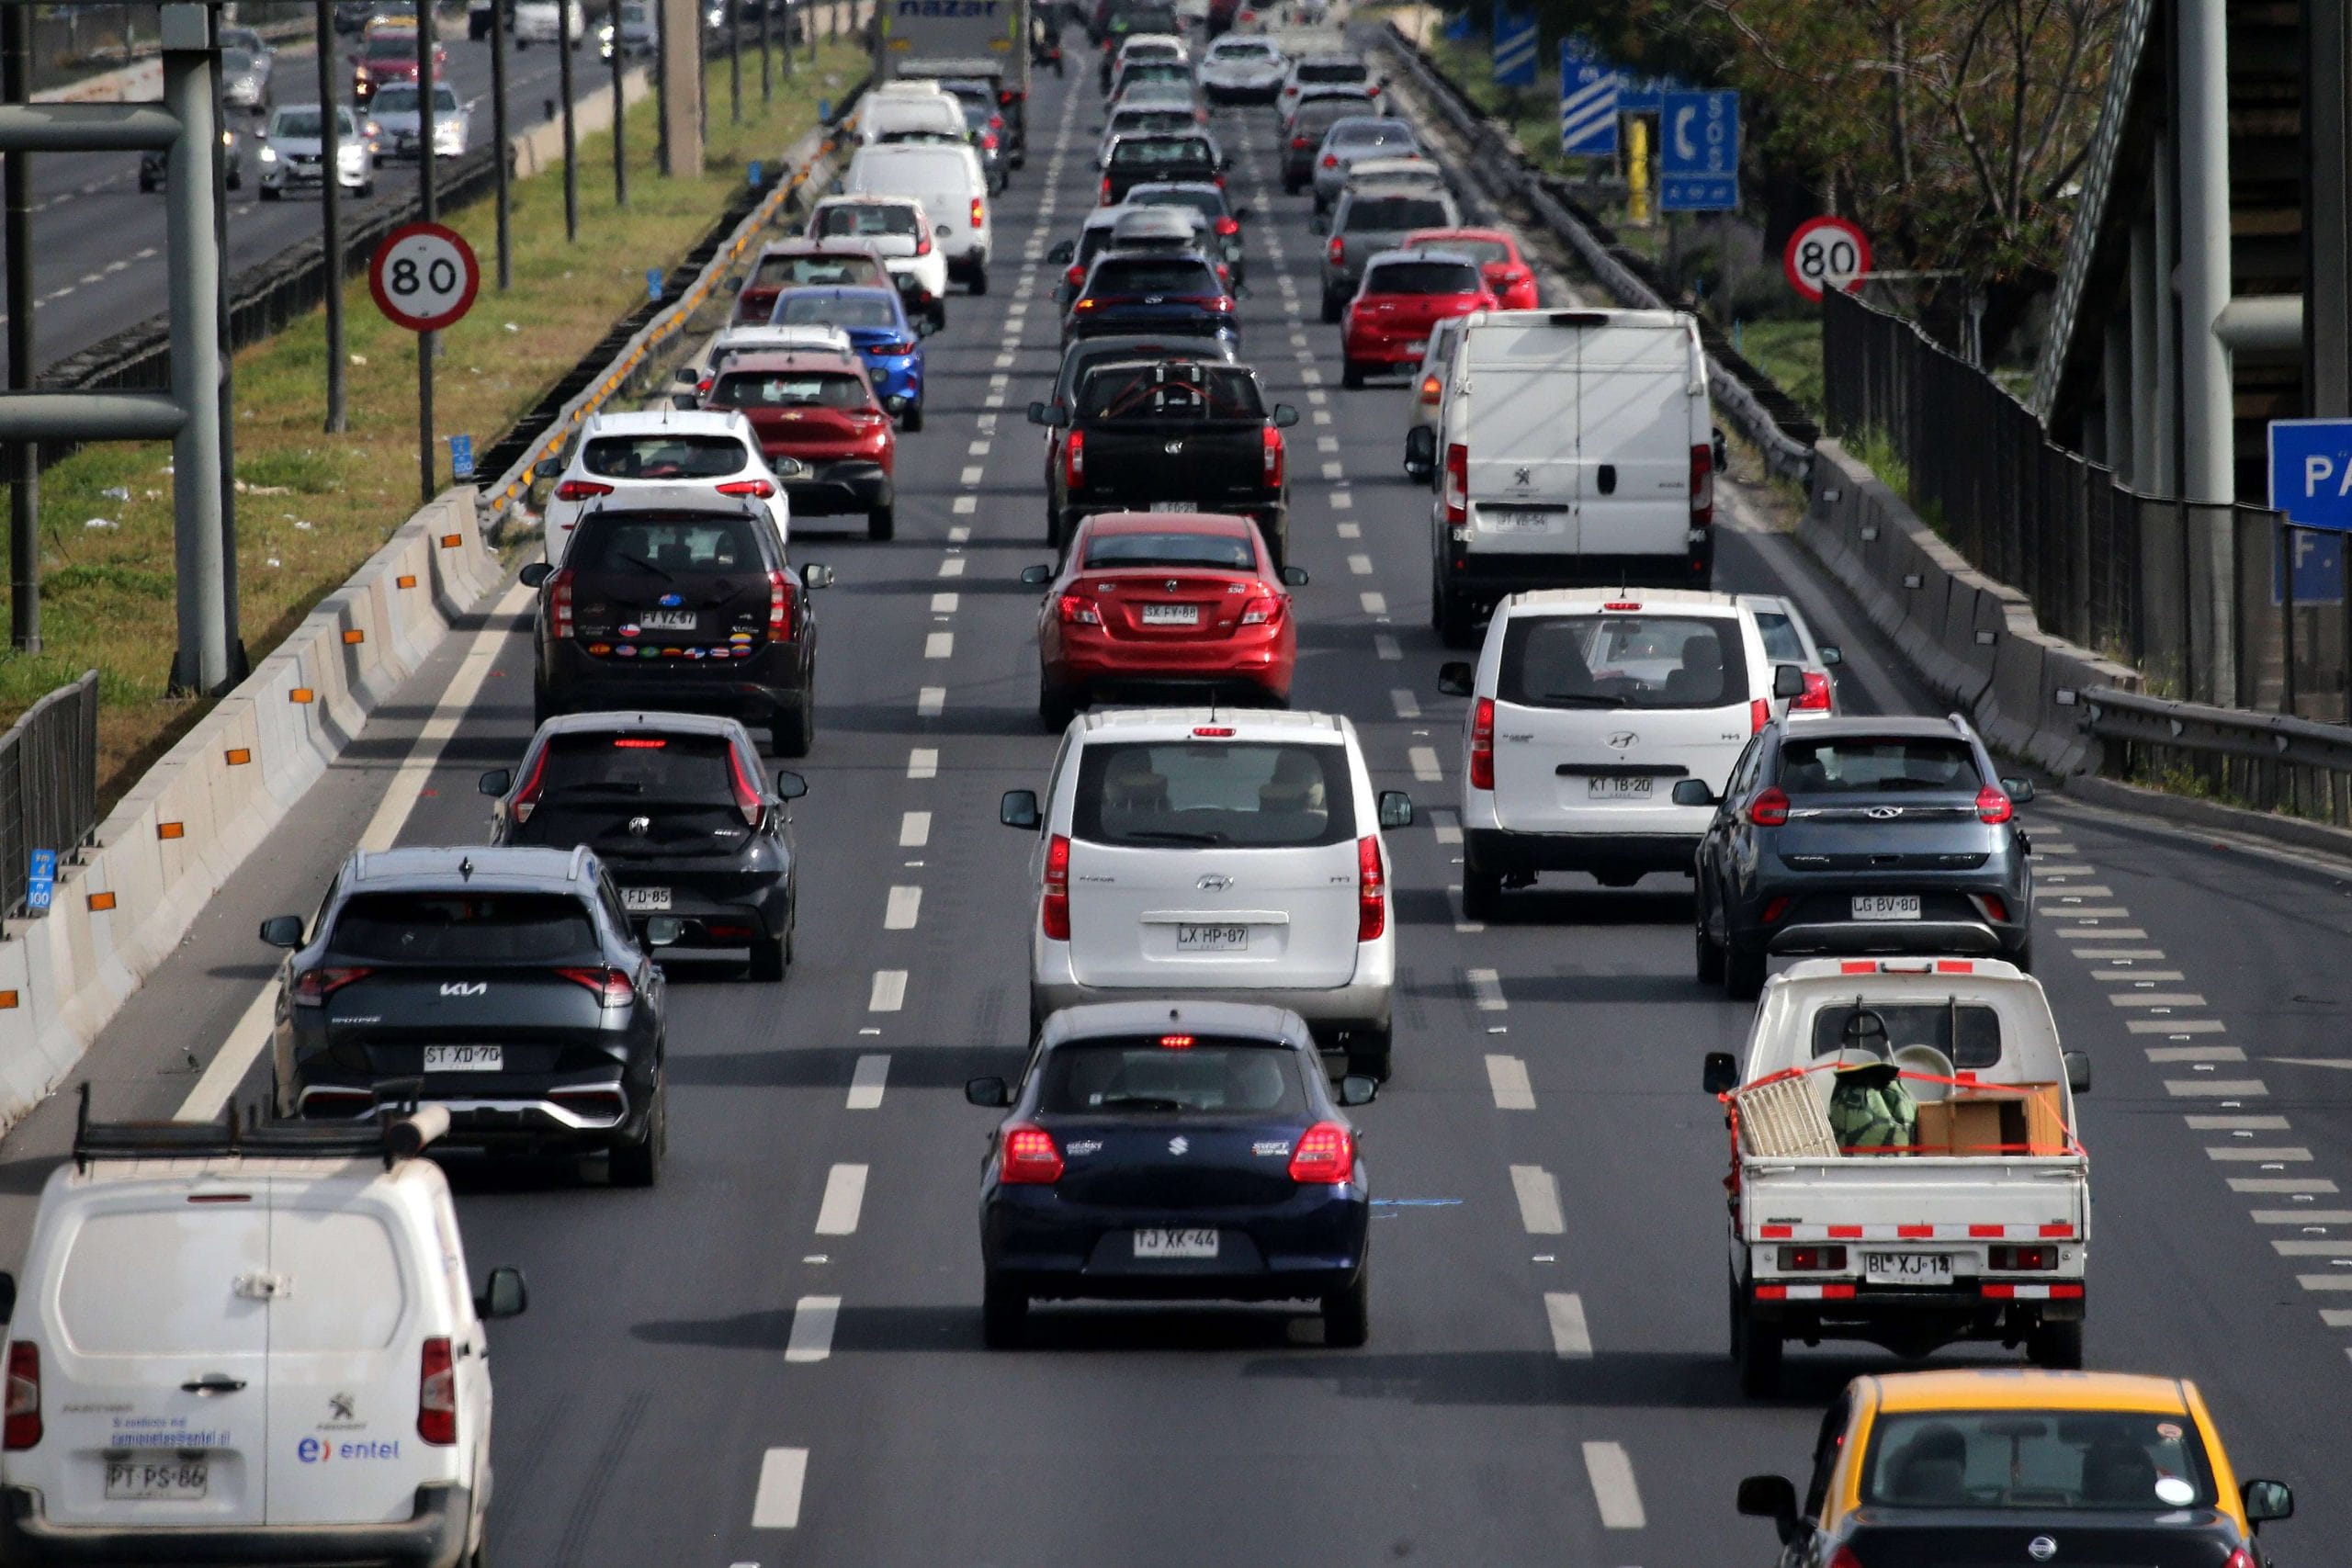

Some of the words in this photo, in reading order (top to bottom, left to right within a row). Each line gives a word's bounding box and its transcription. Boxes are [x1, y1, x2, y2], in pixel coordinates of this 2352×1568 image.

[1803, 242, 1855, 278] 80
[391, 258, 457, 295] 80
[29, 891, 50, 905] 100
[341, 1440, 400, 1460] entel
